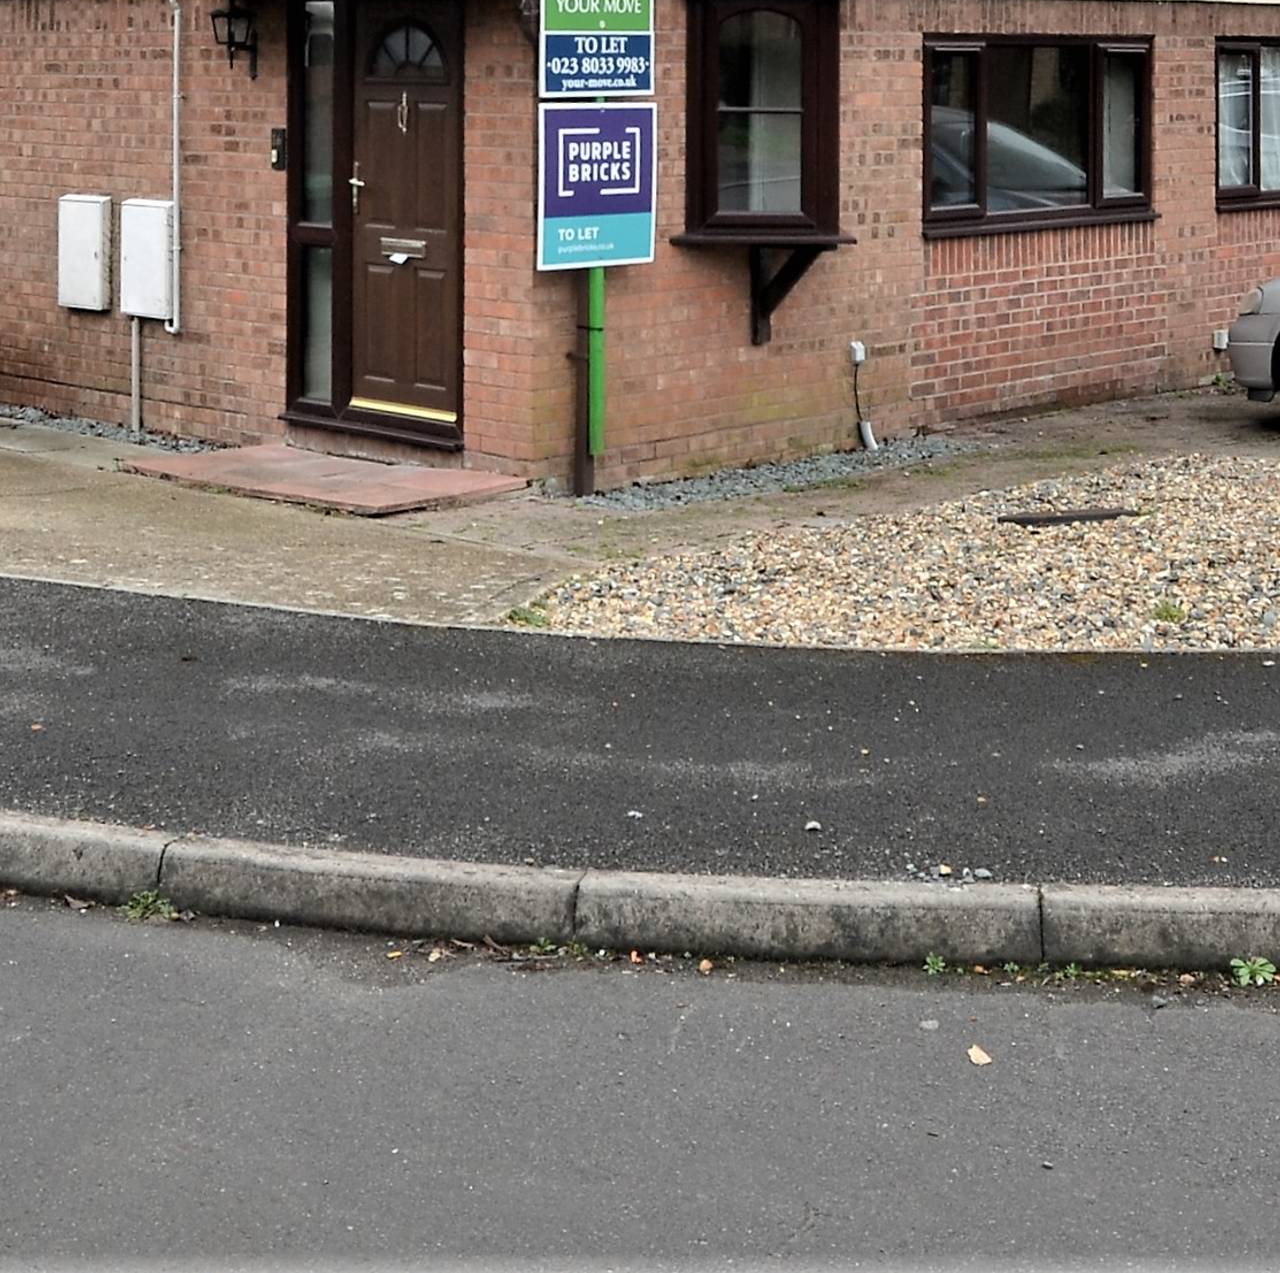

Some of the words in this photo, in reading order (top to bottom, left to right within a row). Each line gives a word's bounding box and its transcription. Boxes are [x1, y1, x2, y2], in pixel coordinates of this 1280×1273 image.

[574, 37, 598, 54] TO
[601, 37, 628, 54] LET
[551, 57, 579, 75] 023
[581, 57, 615, 75] 8033
[616, 56, 646, 75] 9983
[562, 74, 637, 92] your-move.co.uk
[568, 140, 631, 161] PURPLE
[568, 161, 631, 182] BRICKS
[558, 228, 575, 241] TO
[578, 227, 599, 240] LET
